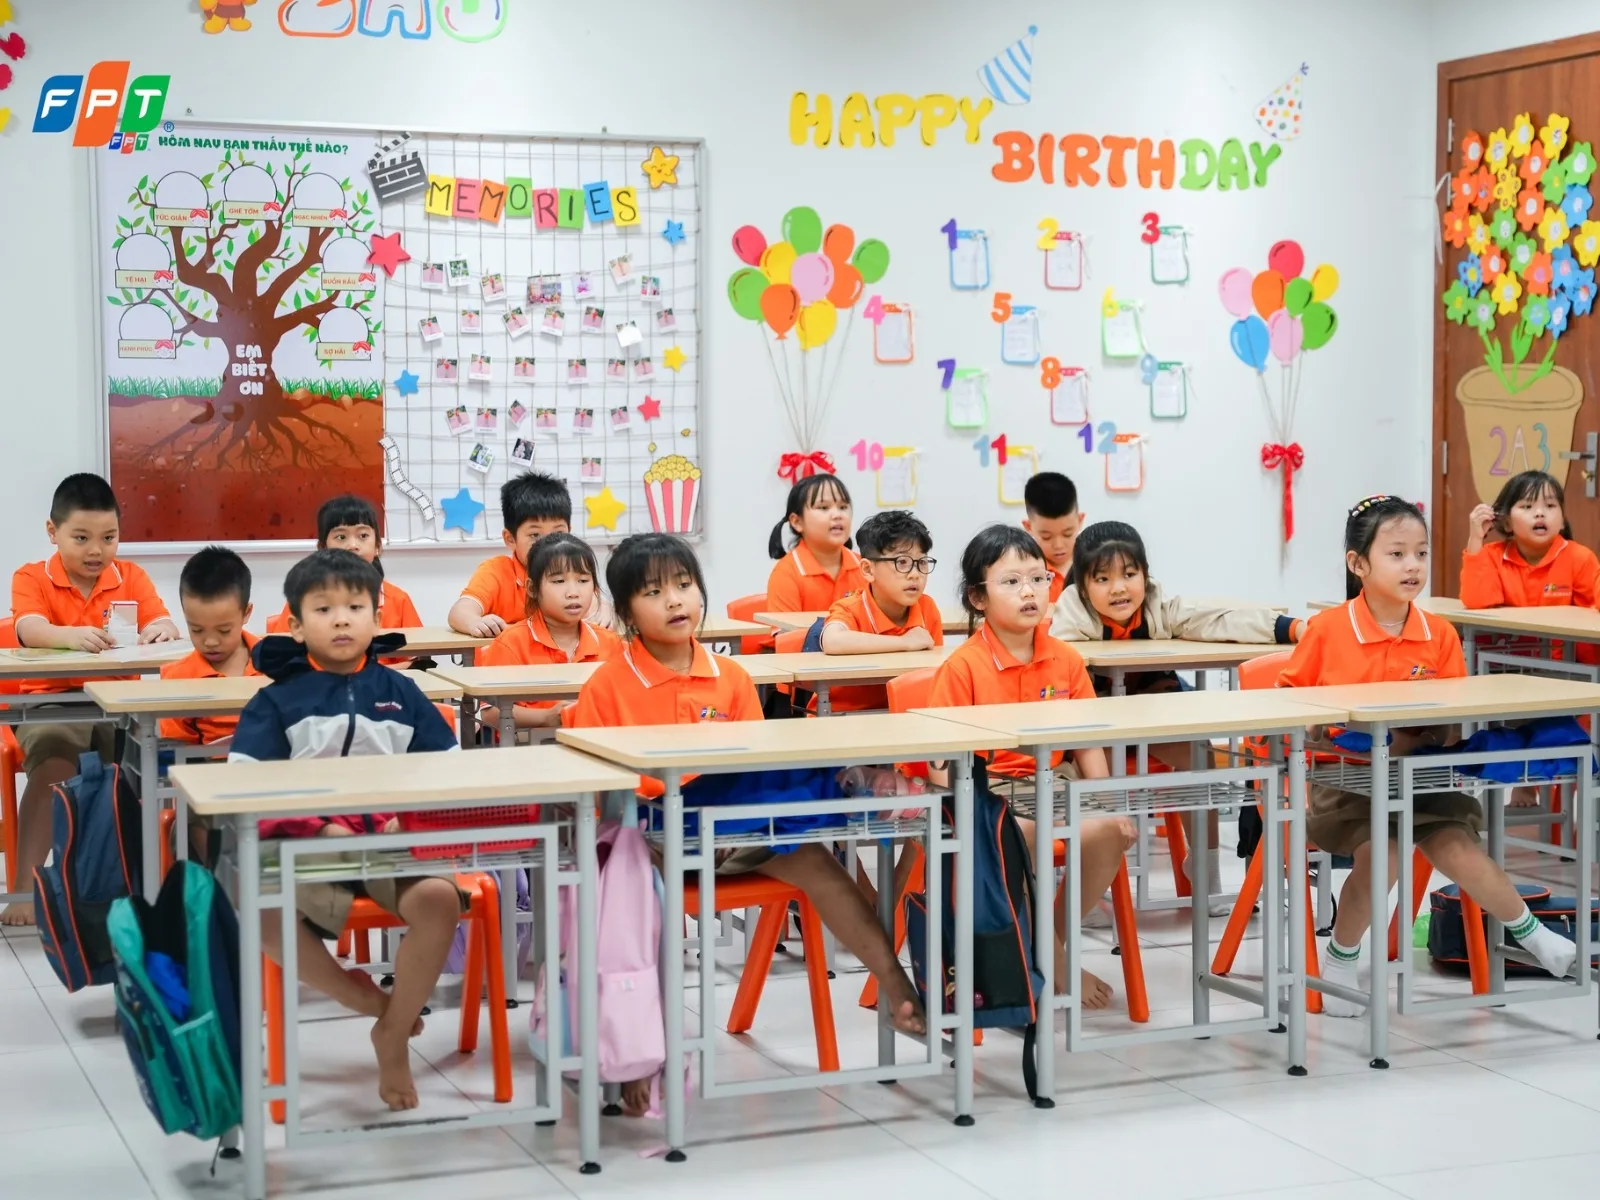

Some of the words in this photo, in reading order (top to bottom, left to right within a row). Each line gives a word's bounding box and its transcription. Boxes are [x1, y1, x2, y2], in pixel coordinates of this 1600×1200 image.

[788, 91, 994, 149] HAPPY
[158, 134, 191, 147] HÔM
[223, 139, 250, 152] BẠN
[288, 137, 313, 153] THẾ
[315, 140, 349, 155] NÀO?
[991, 131, 1283, 191] BIRTHDAY
[429, 180, 637, 224] MEMORIES
[941, 218, 958, 250] 1
[1037, 218, 1059, 250] 2
[1141, 212, 1161, 244] 3
[863, 295, 885, 325] 4
[991, 292, 1012, 323] 5
[1103, 286, 1119, 317] 6
[235, 344, 263, 358] EM
[231, 357, 268, 377] BIẾT
[937, 359, 956, 389] 7
[1041, 357, 1061, 389] 8
[1142, 354, 1158, 385] 9
[239, 380, 264, 396] ƠN
[973, 434, 1007, 468] 11
[1078, 421, 1118, 454] 12
[1489, 422, 1552, 476] 2A3
[850, 440, 884, 471] 10
